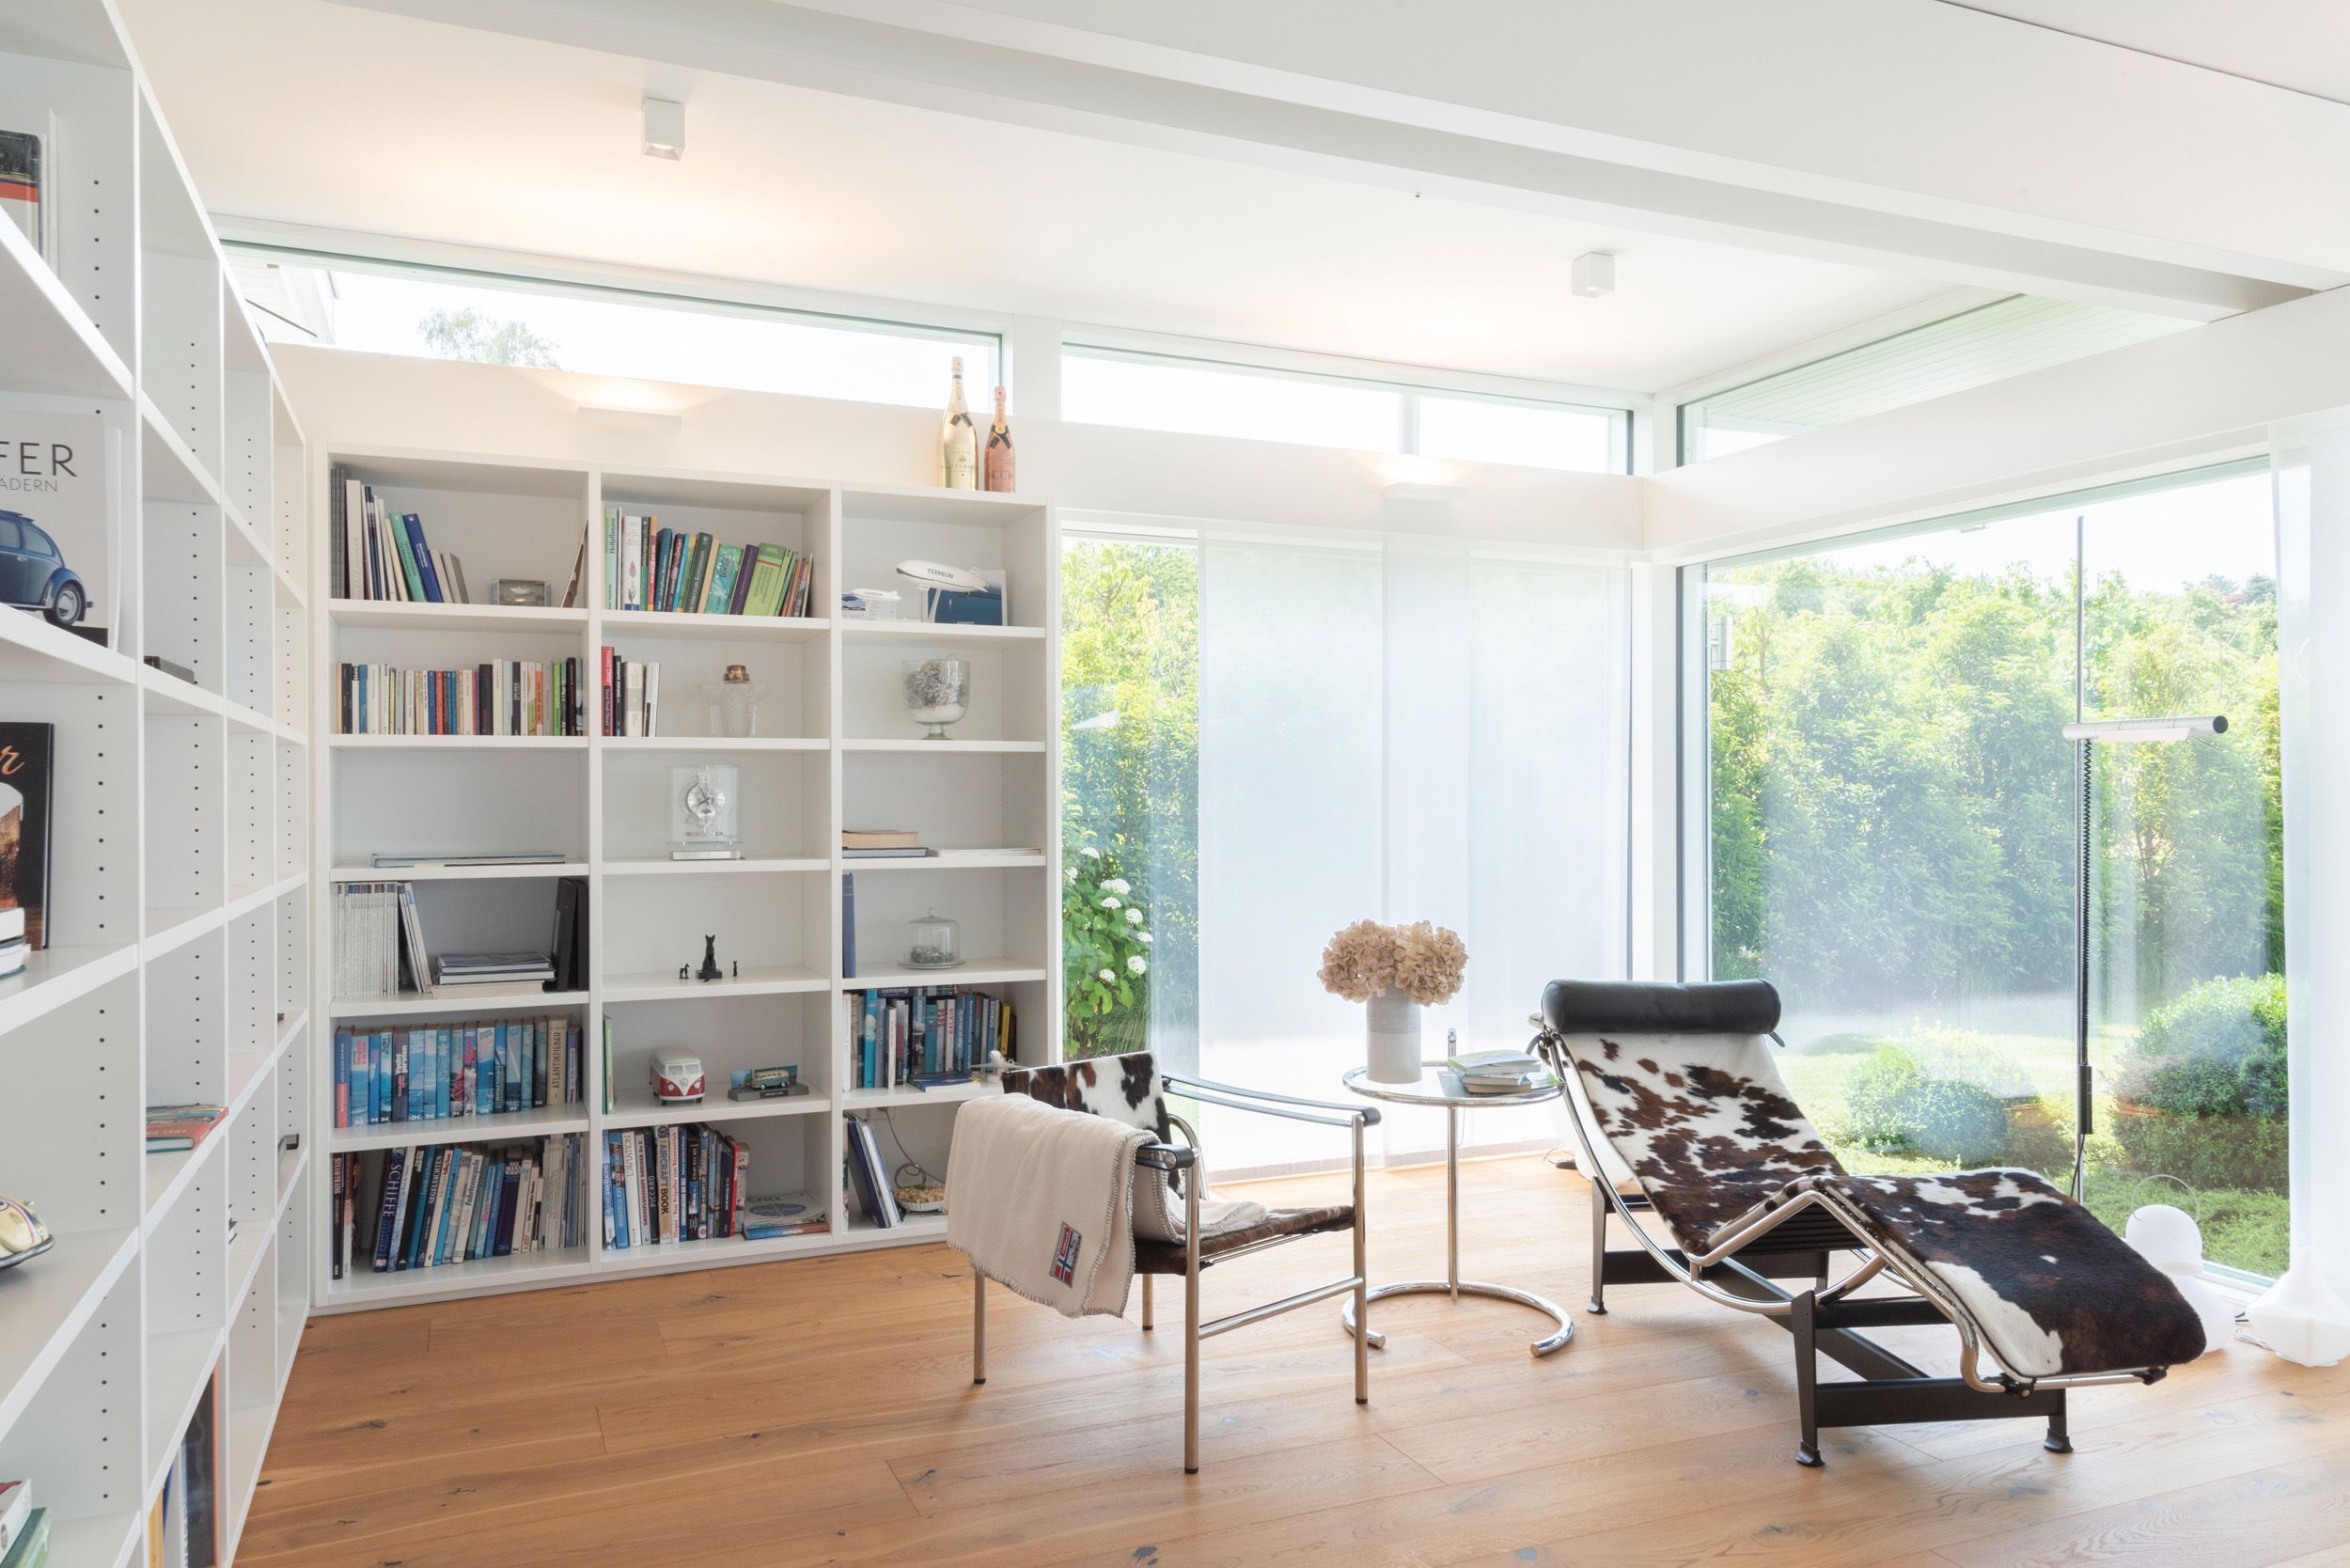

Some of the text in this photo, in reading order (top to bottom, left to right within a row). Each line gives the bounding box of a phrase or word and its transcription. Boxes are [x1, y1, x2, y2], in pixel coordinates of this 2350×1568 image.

[927, 568, 954, 579] ZEPPELIN
[552, 1032, 561, 1089] ATLANTIKFIEBER
[383, 1163, 402, 1217] SCHIFFE
[648, 1175, 657, 1207] PICCARD
[661, 1188, 669, 1215] BOOK
